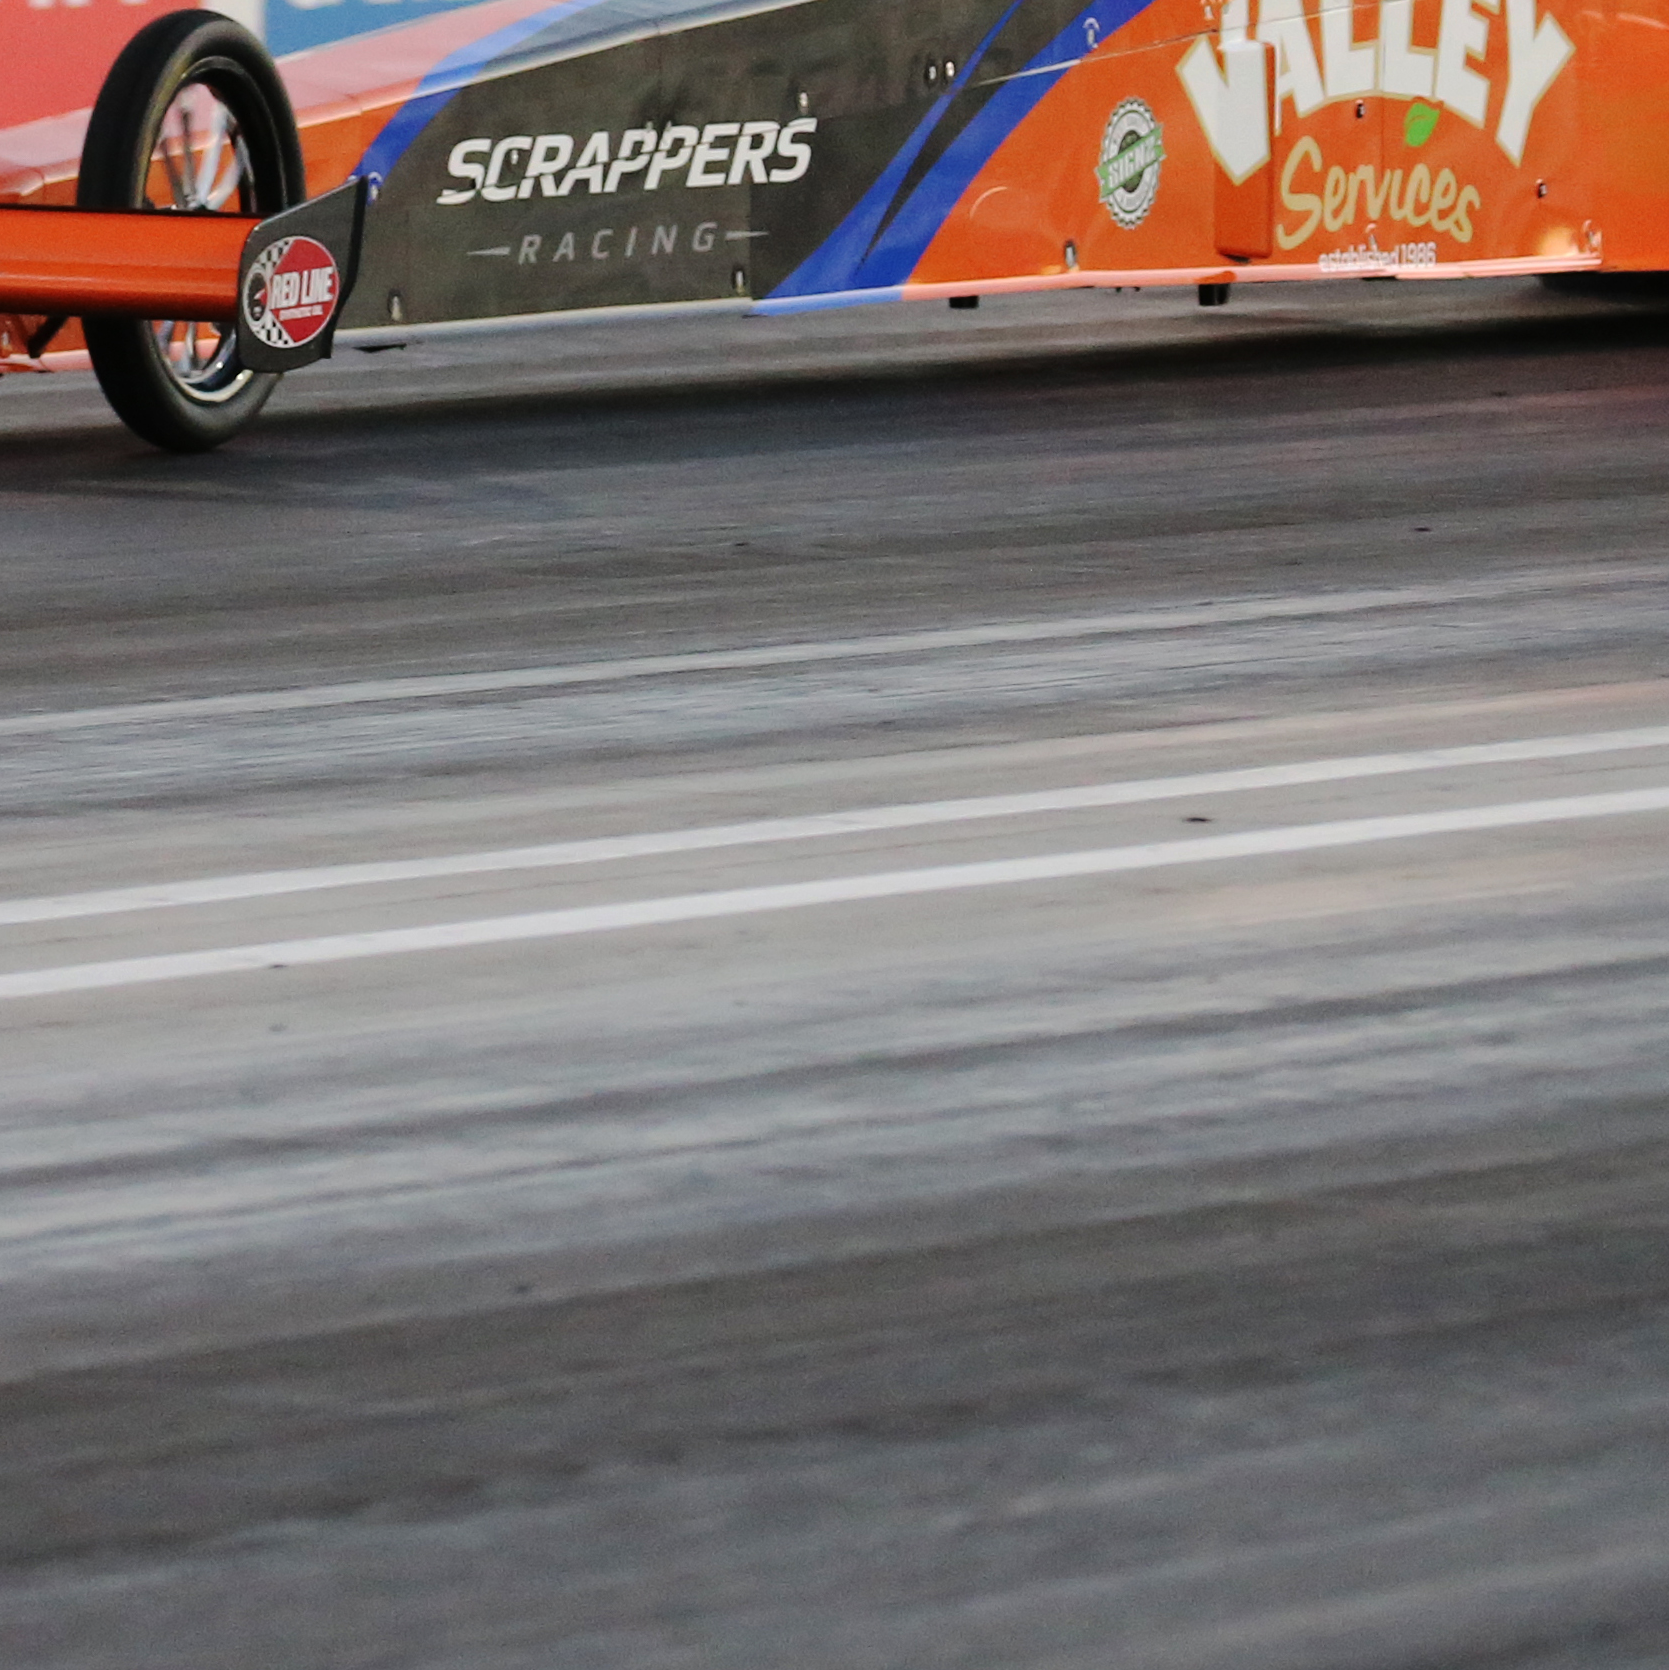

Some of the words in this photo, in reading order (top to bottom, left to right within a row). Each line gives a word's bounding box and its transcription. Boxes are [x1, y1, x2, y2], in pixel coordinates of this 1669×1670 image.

[436, 117, 818, 205] SCRAPPERS
[1275, 134, 1481, 251] Services
[518, 221, 719, 264] RACING
[1400, 240, 1437, 268] 1986
[270, 271, 301, 310] RED
[300, 266, 334, 306] LINE
